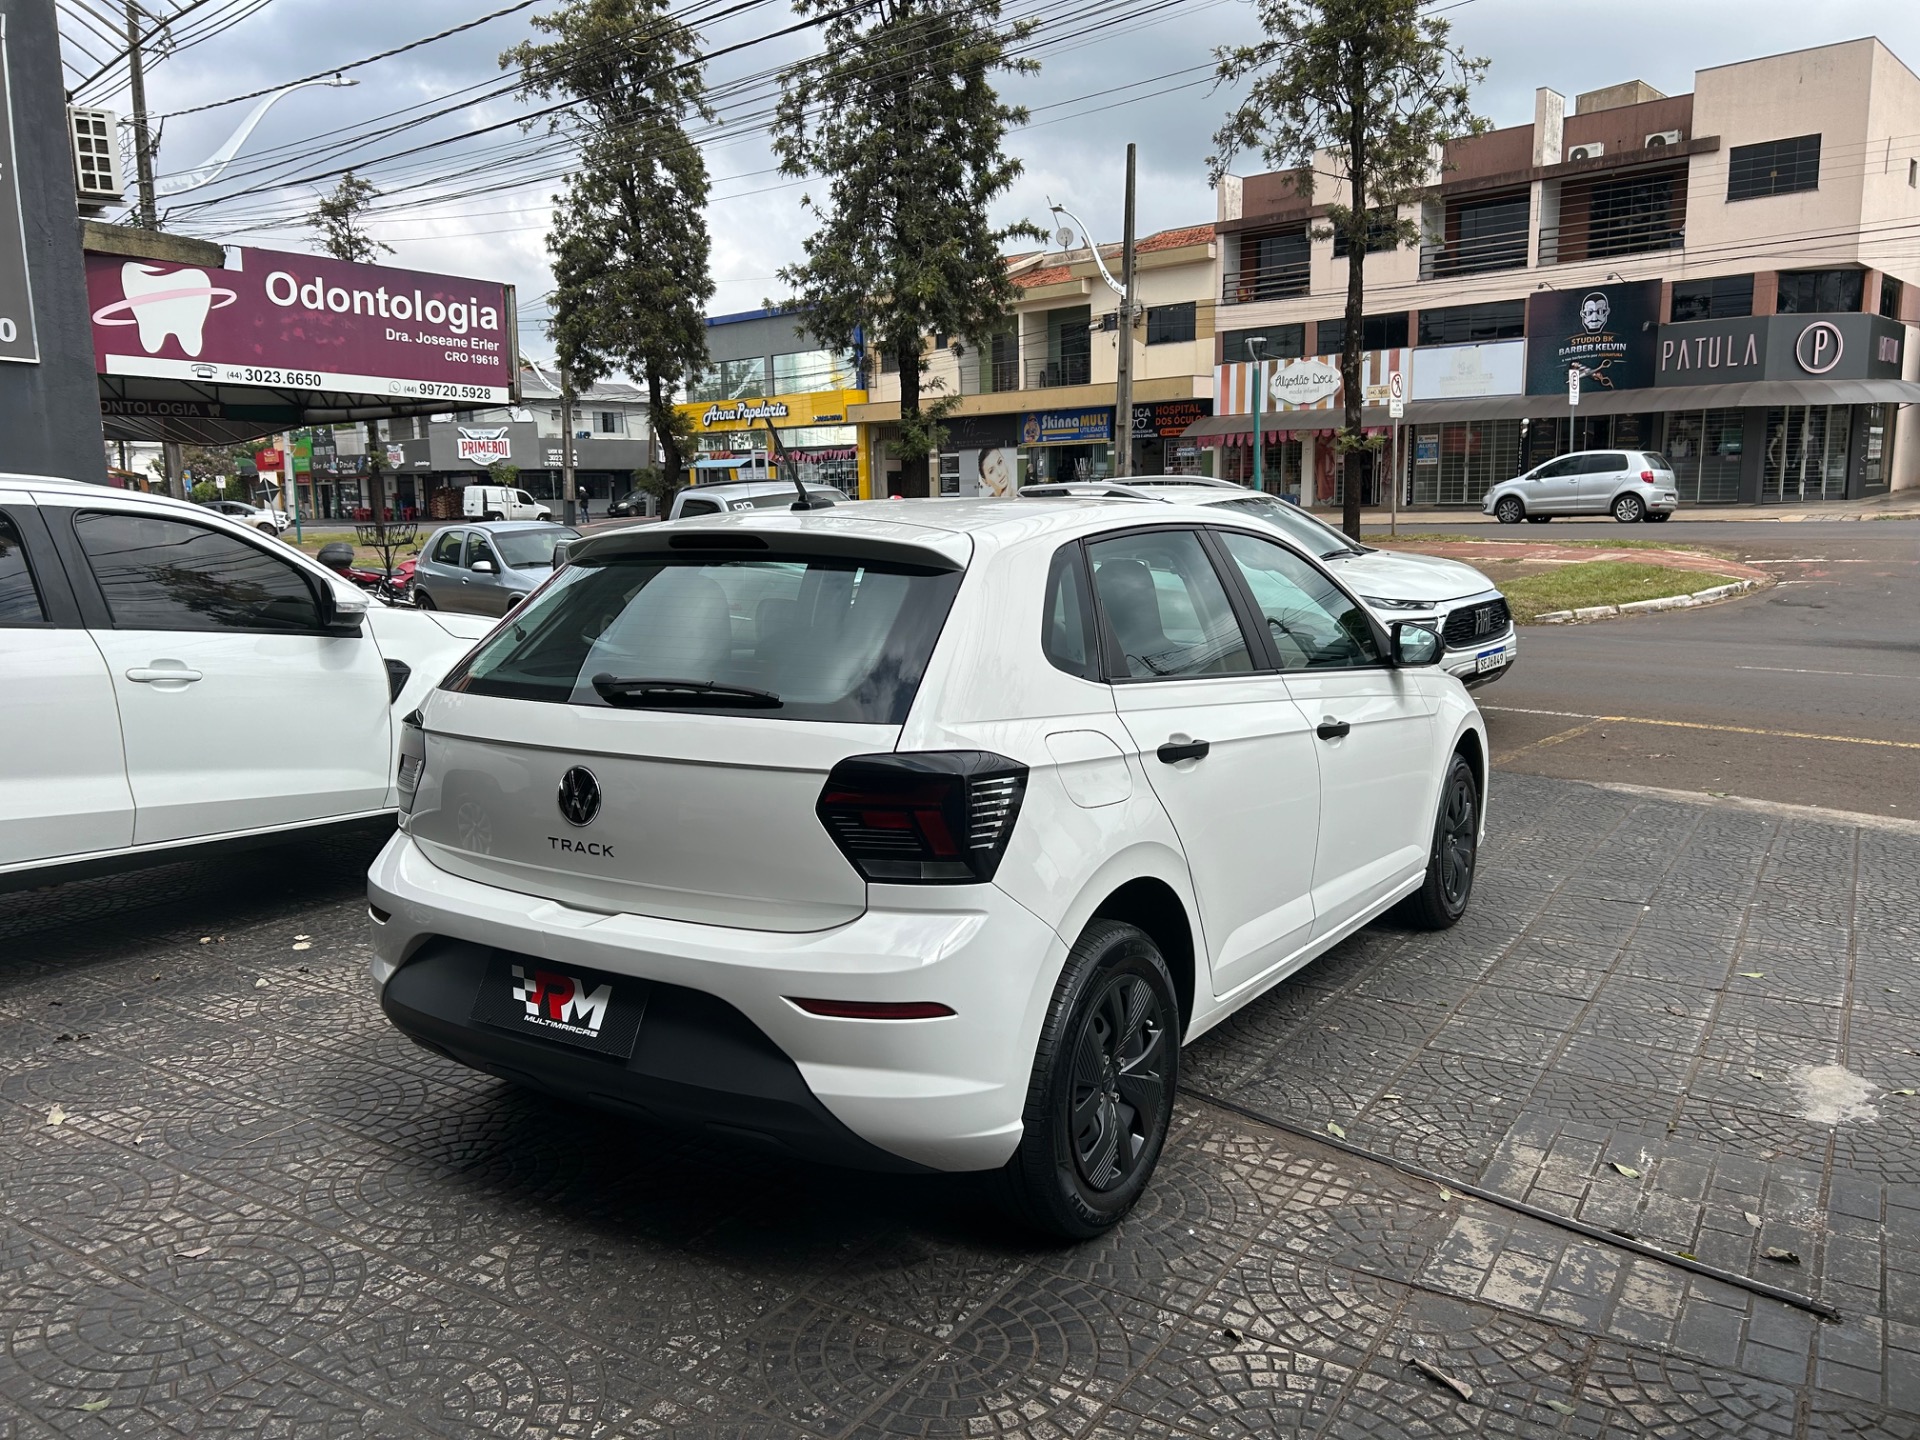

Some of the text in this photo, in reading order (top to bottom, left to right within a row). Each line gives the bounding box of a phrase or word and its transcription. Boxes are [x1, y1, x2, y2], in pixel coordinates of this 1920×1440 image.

[265, 271, 498, 334] Odontologia
[385, 328, 500, 351] Dra. Joseane Erler
[1571, 336, 1601, 346] STUDIO
[1813, 329, 1829, 366] P
[444, 351, 500, 366] CRO 19618
[1558, 343, 1594, 356] BARBER
[1661, 333, 1758, 372] PATULA
[226, 368, 322, 387] (44) 3023.6650
[1275, 373, 1335, 389] Algodão Doce
[403, 383, 491, 400] (44) 99720.5928
[703, 400, 788, 427] Anna Papelaria
[1155, 403, 1201, 415] HOSPITAL
[1155, 416, 1172, 426] DOS
[461, 440, 508, 457] PRIMEBOI
[548, 836, 615, 858] TRACK
[523, 1014, 599, 1038] MULTIMARCAS
